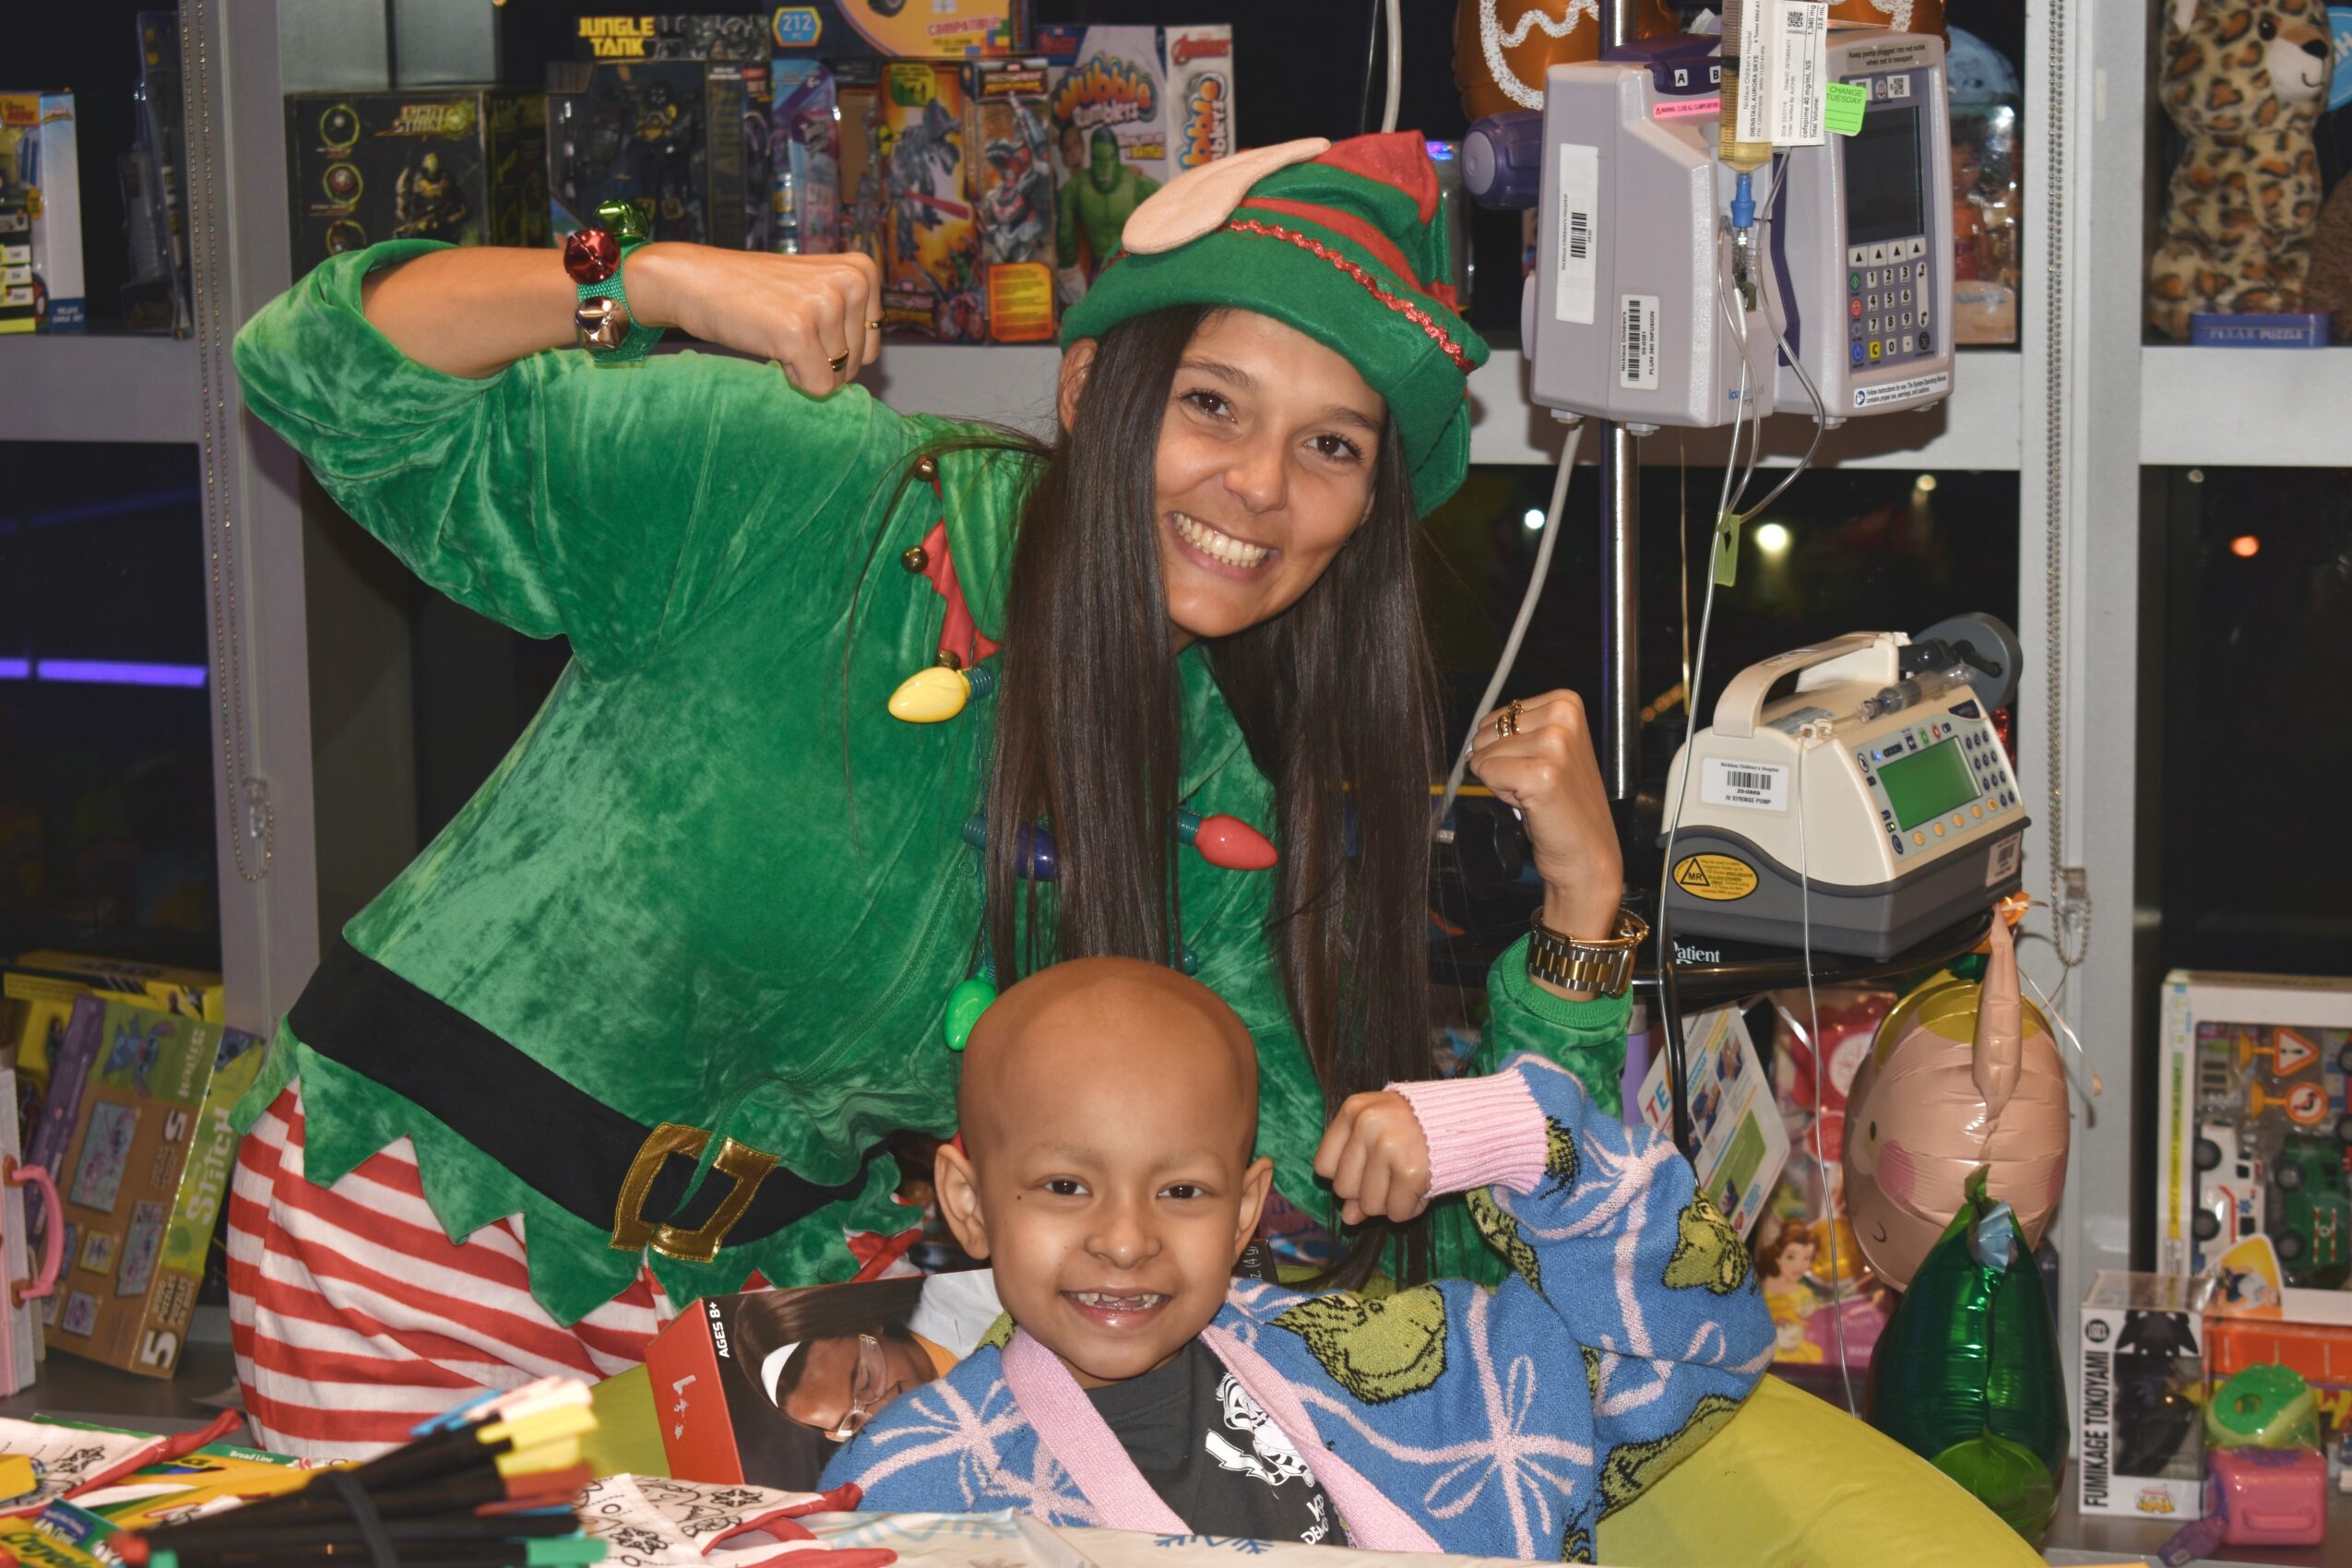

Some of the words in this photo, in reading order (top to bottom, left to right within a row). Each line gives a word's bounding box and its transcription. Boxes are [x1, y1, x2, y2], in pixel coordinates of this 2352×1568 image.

[1809, 5, 1816, 16] mg
[1818, 6, 1825, 16] mL
[578, 17, 656, 38] JUNGLE
[782, 15, 811, 31] 212
[590, 37, 646, 56] TANK
[1848, 51, 1861, 59] Keep
[1805, 60, 1812, 70] NS
[1678, 73, 1685, 84] A
[1713, 69, 1719, 80] B
[1804, 72, 1812, 96] mg/mL
[1829, 86, 1863, 97] CHANGE
[1803, 97, 1810, 105] 40
[1827, 93, 1862, 105] TUESDAY
[1181, 77, 1229, 170] bble
[1802, 107, 1811, 138] cefepime
[1870, 272, 1874, 282] 1
[1886, 269, 1892, 280] 2
[1903, 267, 1908, 278] 3
[1870, 295, 1876, 305] 4
[1887, 293, 1893, 303] 5
[1903, 291, 1909, 302] 6
[1871, 319, 1877, 330] 7
[1888, 316, 1894, 327] 8
[1904, 313, 1909, 325] 9
[2260, 328, 2303, 339] PUZZLE
[1872, 344, 1878, 355] C
[1888, 341, 1895, 352] 0
[1732, 795, 1754, 803] SYRINGE
[1688, 873, 1703, 882] MR
[709, 1301, 721, 1319] 8+
[712, 1322, 730, 1359] AGES
[139, 1329, 179, 1369] 5
[2084, 1351, 2110, 1425] TOKOYAMI
[231, 1450, 255, 1462] Broad
[255, 1453, 274, 1464] Line
[2084, 1430, 2109, 1507] FUMIKAGE
